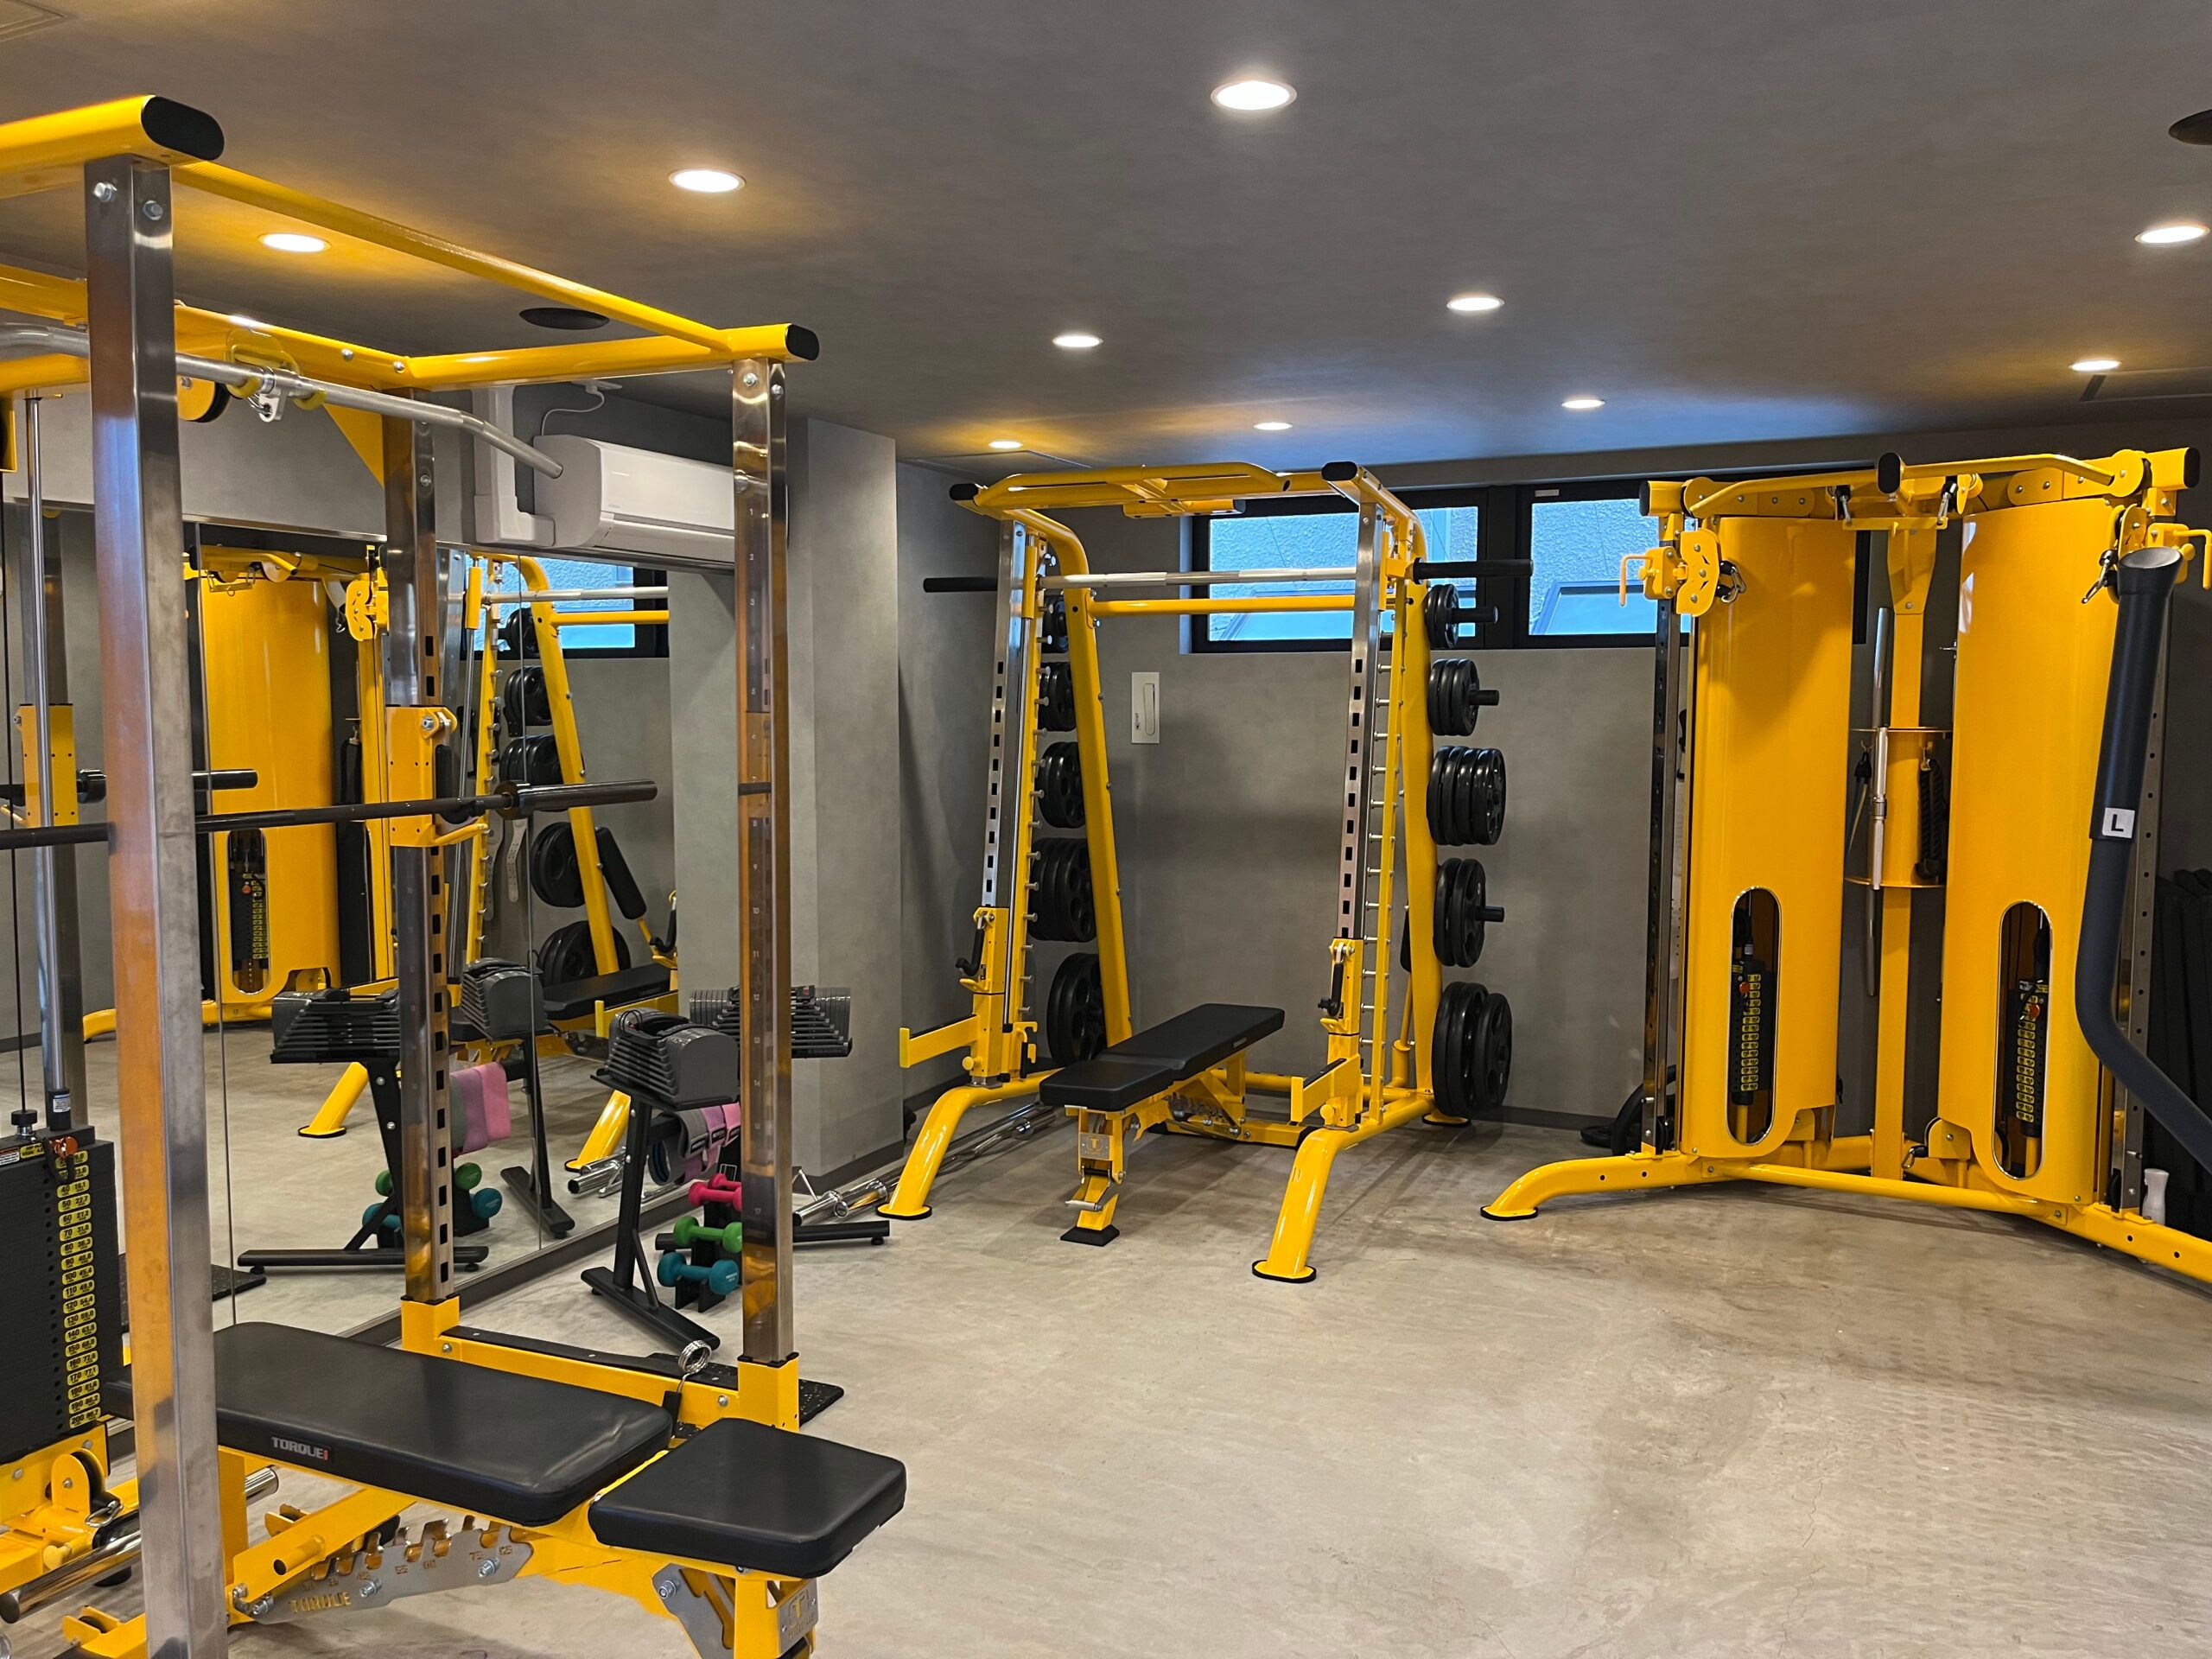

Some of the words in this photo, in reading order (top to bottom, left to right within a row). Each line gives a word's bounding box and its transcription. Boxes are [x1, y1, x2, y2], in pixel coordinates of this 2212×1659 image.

[2111, 813, 2125, 832] L
[75, 1195, 88, 1205] 22.7
[63, 1214, 72, 1223] 60
[64, 1229, 73, 1237] 70
[65, 1271, 77, 1281] 100
[79, 1267, 92, 1276] 45.4
[66, 1286, 77, 1294] 110
[66, 1300, 78, 1309] 120
[79, 1295, 92, 1305] 54.4
[67, 1315, 79, 1324] 130
[67, 1329, 79, 1338] 140
[68, 1343, 80, 1352] 150
[69, 1357, 81, 1367] 160
[70, 1372, 82, 1381] 170
[85, 1367, 96, 1376] 77.1
[71, 1414, 85, 1424] 200
[271, 1436, 324, 1460] TORQUE
